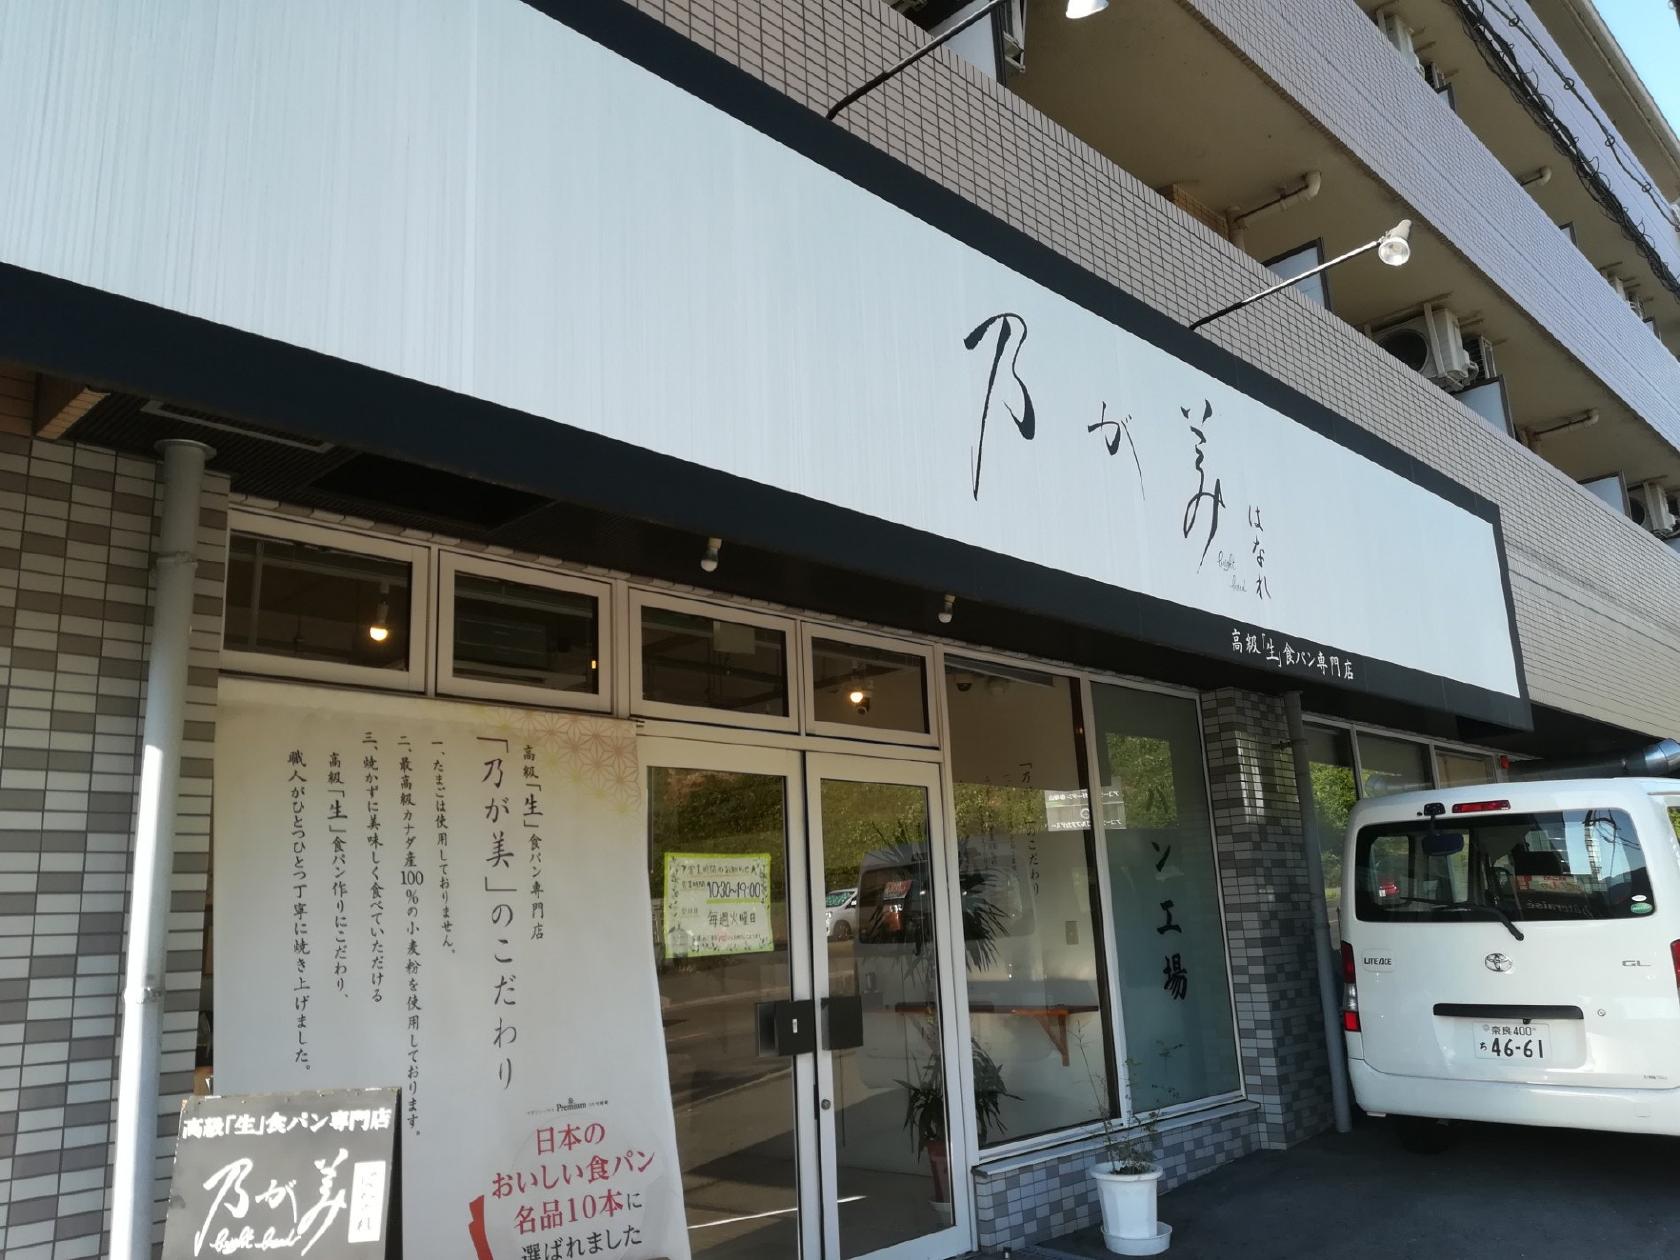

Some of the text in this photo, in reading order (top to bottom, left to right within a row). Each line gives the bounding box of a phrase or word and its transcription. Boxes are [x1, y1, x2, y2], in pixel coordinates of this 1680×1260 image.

[1248, 504, 1272, 600] はなれ
[1231, 628, 1354, 680] 高級「生」食パン専門店
[362, 731, 385, 1004] 三、焼かずに美味しく食べていただける
[522, 744, 545, 941] 高級「生」食パン専門店
[327, 751, 349, 999] 高級「生」食パン作りにこだわり、
[287, 749, 311, 1071] 職人がひとつひとつ丁寧に焼き上げました。
[476, 736, 518, 1090] 「乃が美」のこだわり
[1491, 1037, 1544, 1058] 46-61
[1513, 1026, 1532, 1036] 400
[182, 1106, 393, 1140] 高級「生」食パン専門店
[556, 1102, 587, 1113] Premium
[536, 1122, 606, 1156] 日本の
[491, 1150, 656, 1200] おいしい食パン
[193, 1147, 349, 1257] 乃が美
[513, 1188, 643, 1235] 名品10本に
[521, 1224, 643, 1260] 選ばれました
